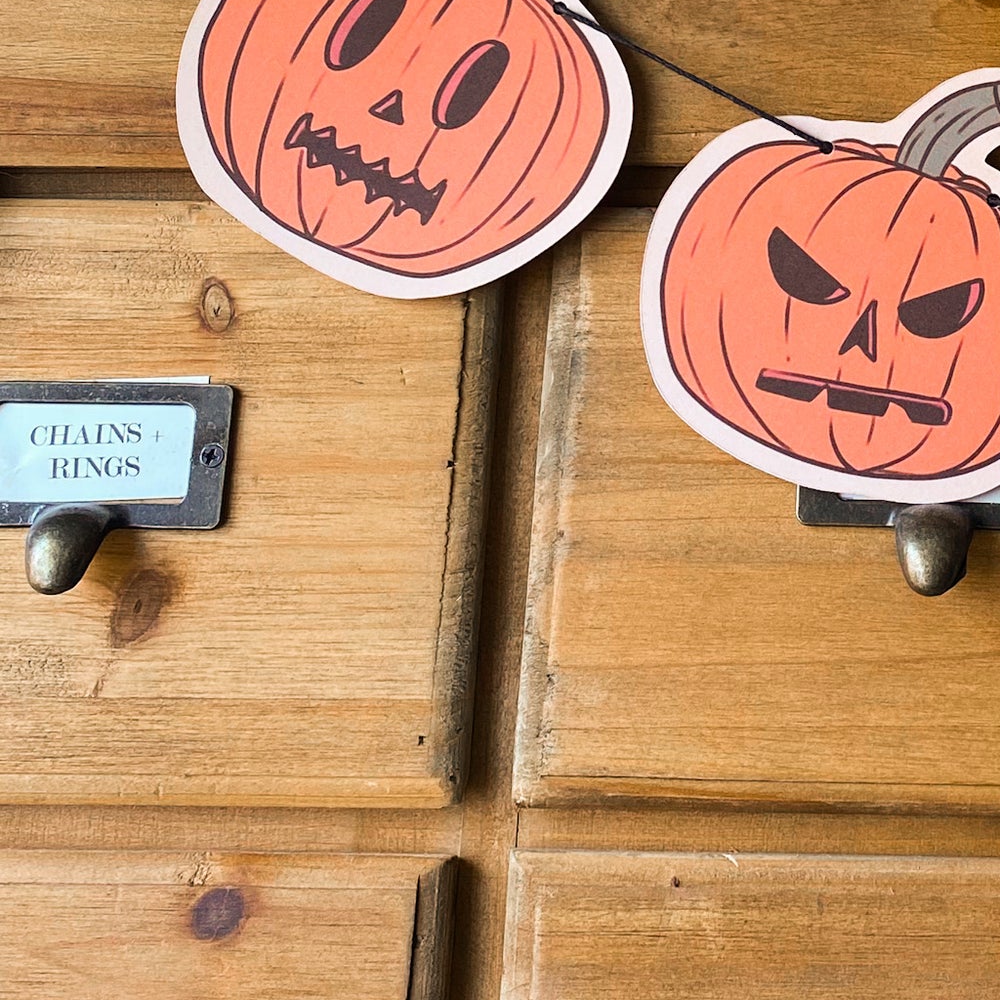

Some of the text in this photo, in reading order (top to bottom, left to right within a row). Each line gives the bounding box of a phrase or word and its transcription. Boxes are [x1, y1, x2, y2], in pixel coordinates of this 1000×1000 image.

[30, 422, 165, 446] CHAINS +
[49, 455, 141, 479] RINGS
